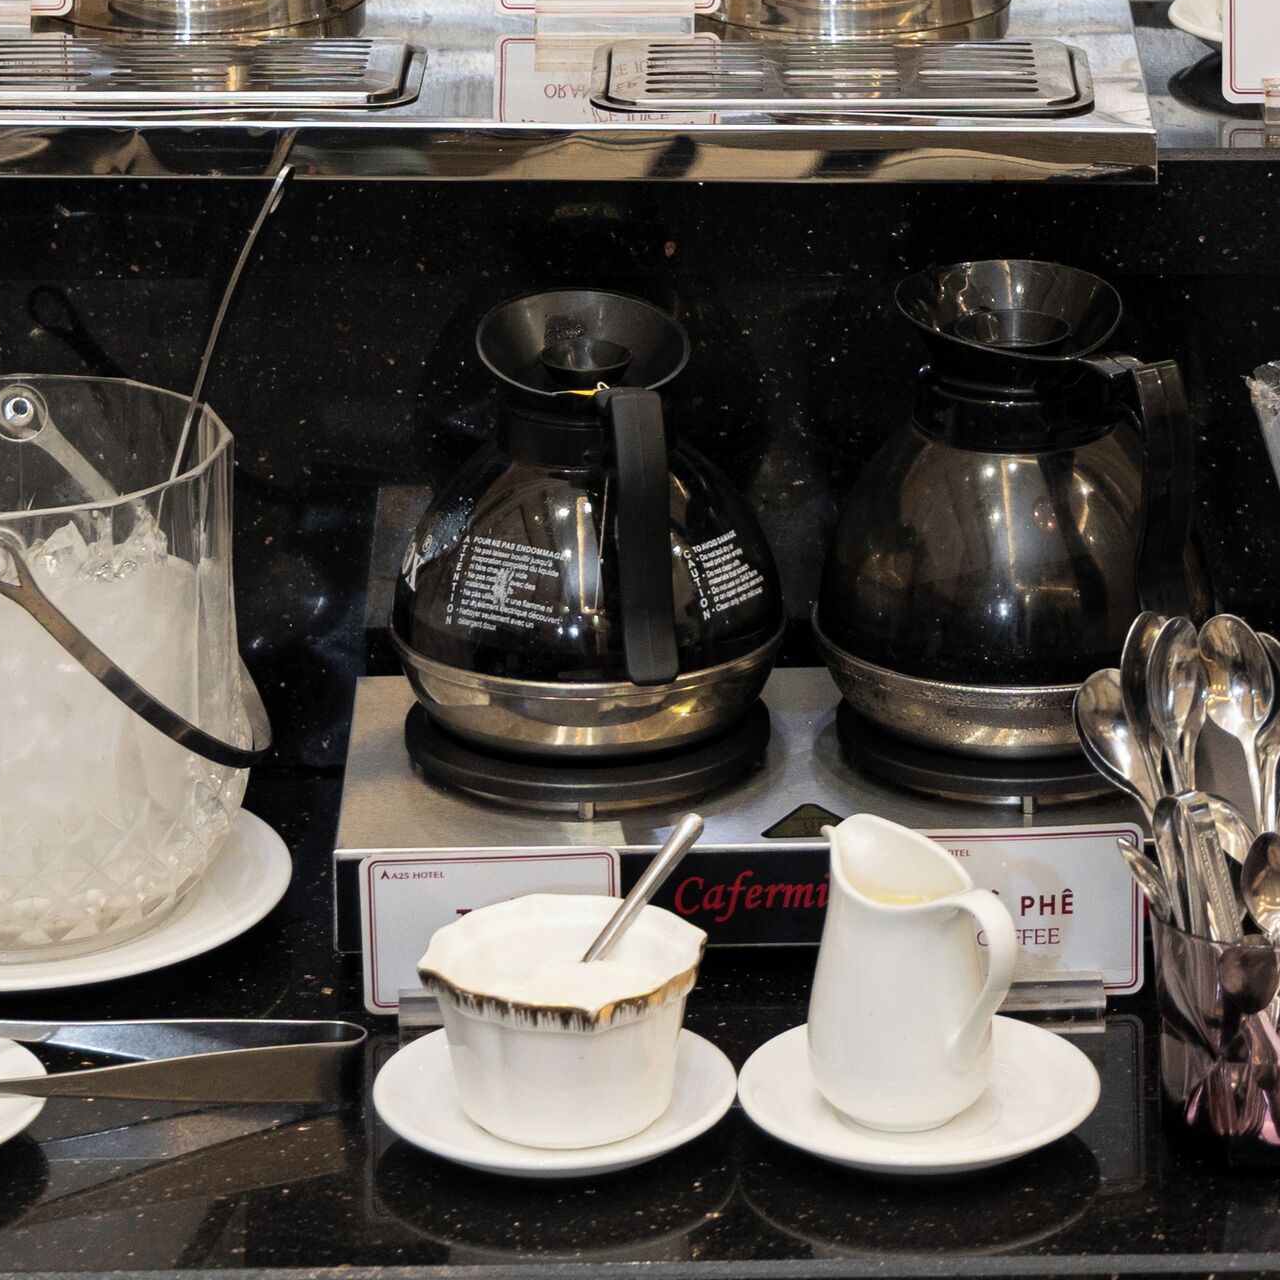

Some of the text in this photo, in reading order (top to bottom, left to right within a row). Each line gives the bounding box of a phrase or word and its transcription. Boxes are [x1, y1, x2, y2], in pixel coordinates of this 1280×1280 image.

[473, 535, 492, 546] POUR
[491, 539, 501, 547] NE
[501, 541, 516, 550] PAS
[445, 535, 470, 625] ATTENTION
[683, 550, 711, 620] CAUTION
[391, 871, 445, 880] A25 HOTEL
[673, 870, 830, 923] Cafermi
[1020, 888, 1074, 917] PHÊ
[976, 927, 1061, 947] CFEE
